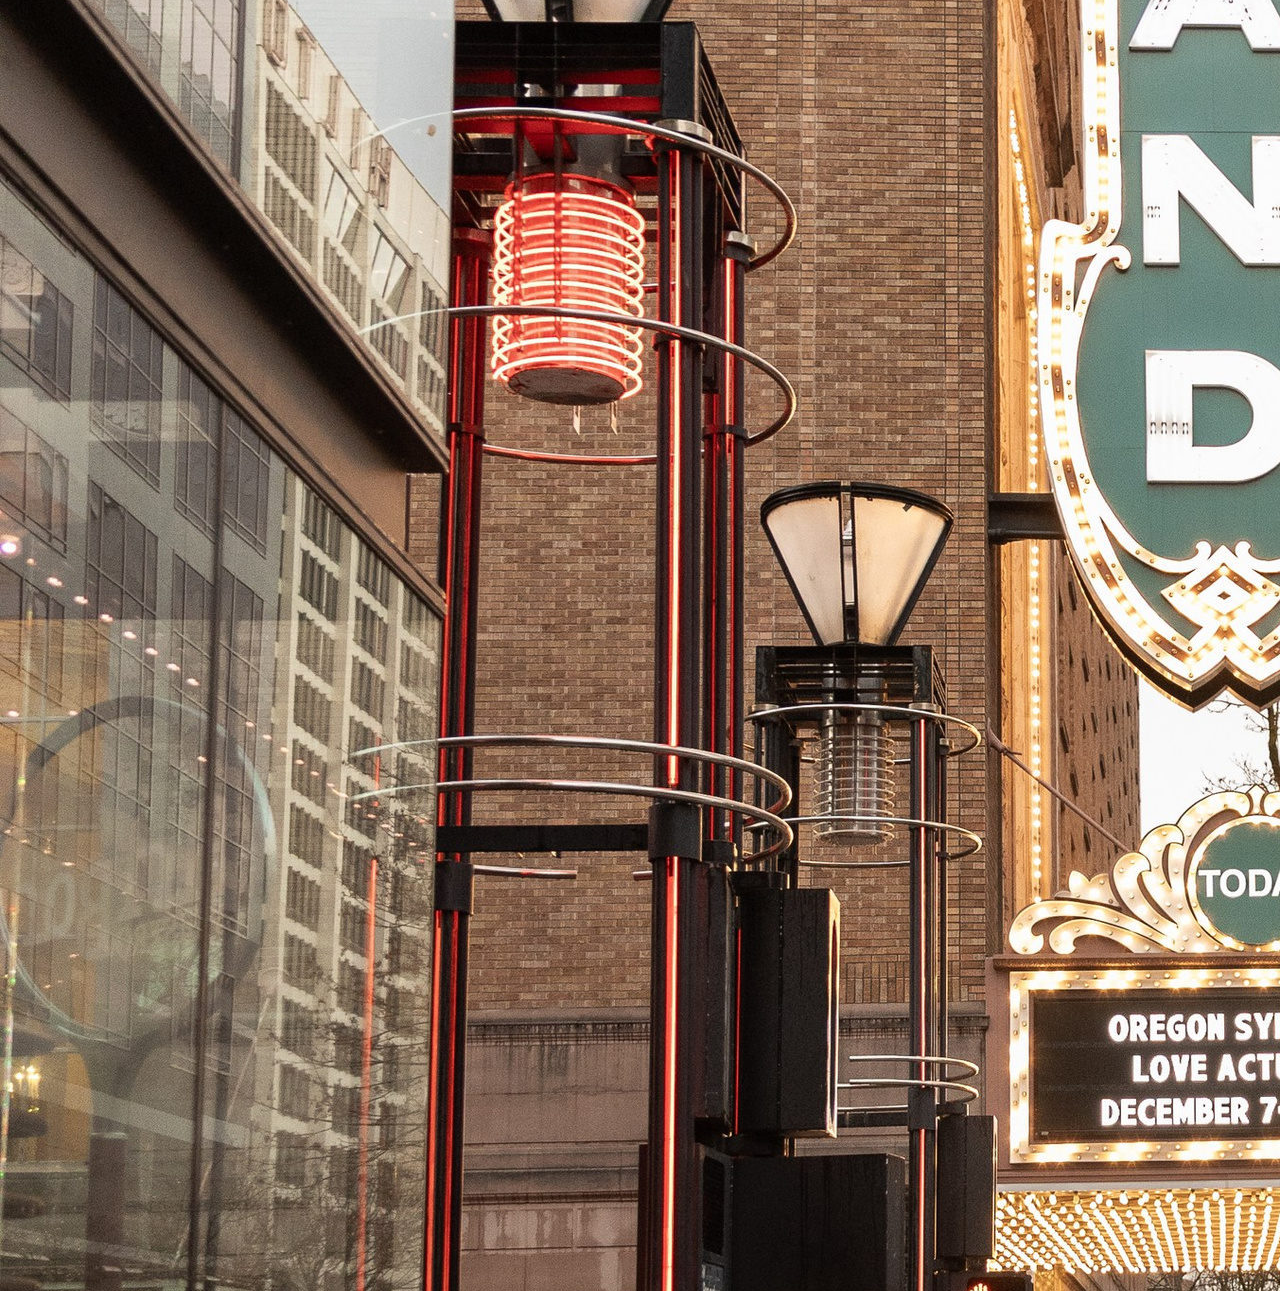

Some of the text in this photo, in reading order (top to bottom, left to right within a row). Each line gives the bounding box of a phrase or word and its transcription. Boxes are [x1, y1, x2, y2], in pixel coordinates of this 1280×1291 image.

[1108, 1013, 1226, 1042] OREGON
[1132, 1054, 1208, 1083] LOVE
[1100, 1096, 1250, 1126] DECEMBER
